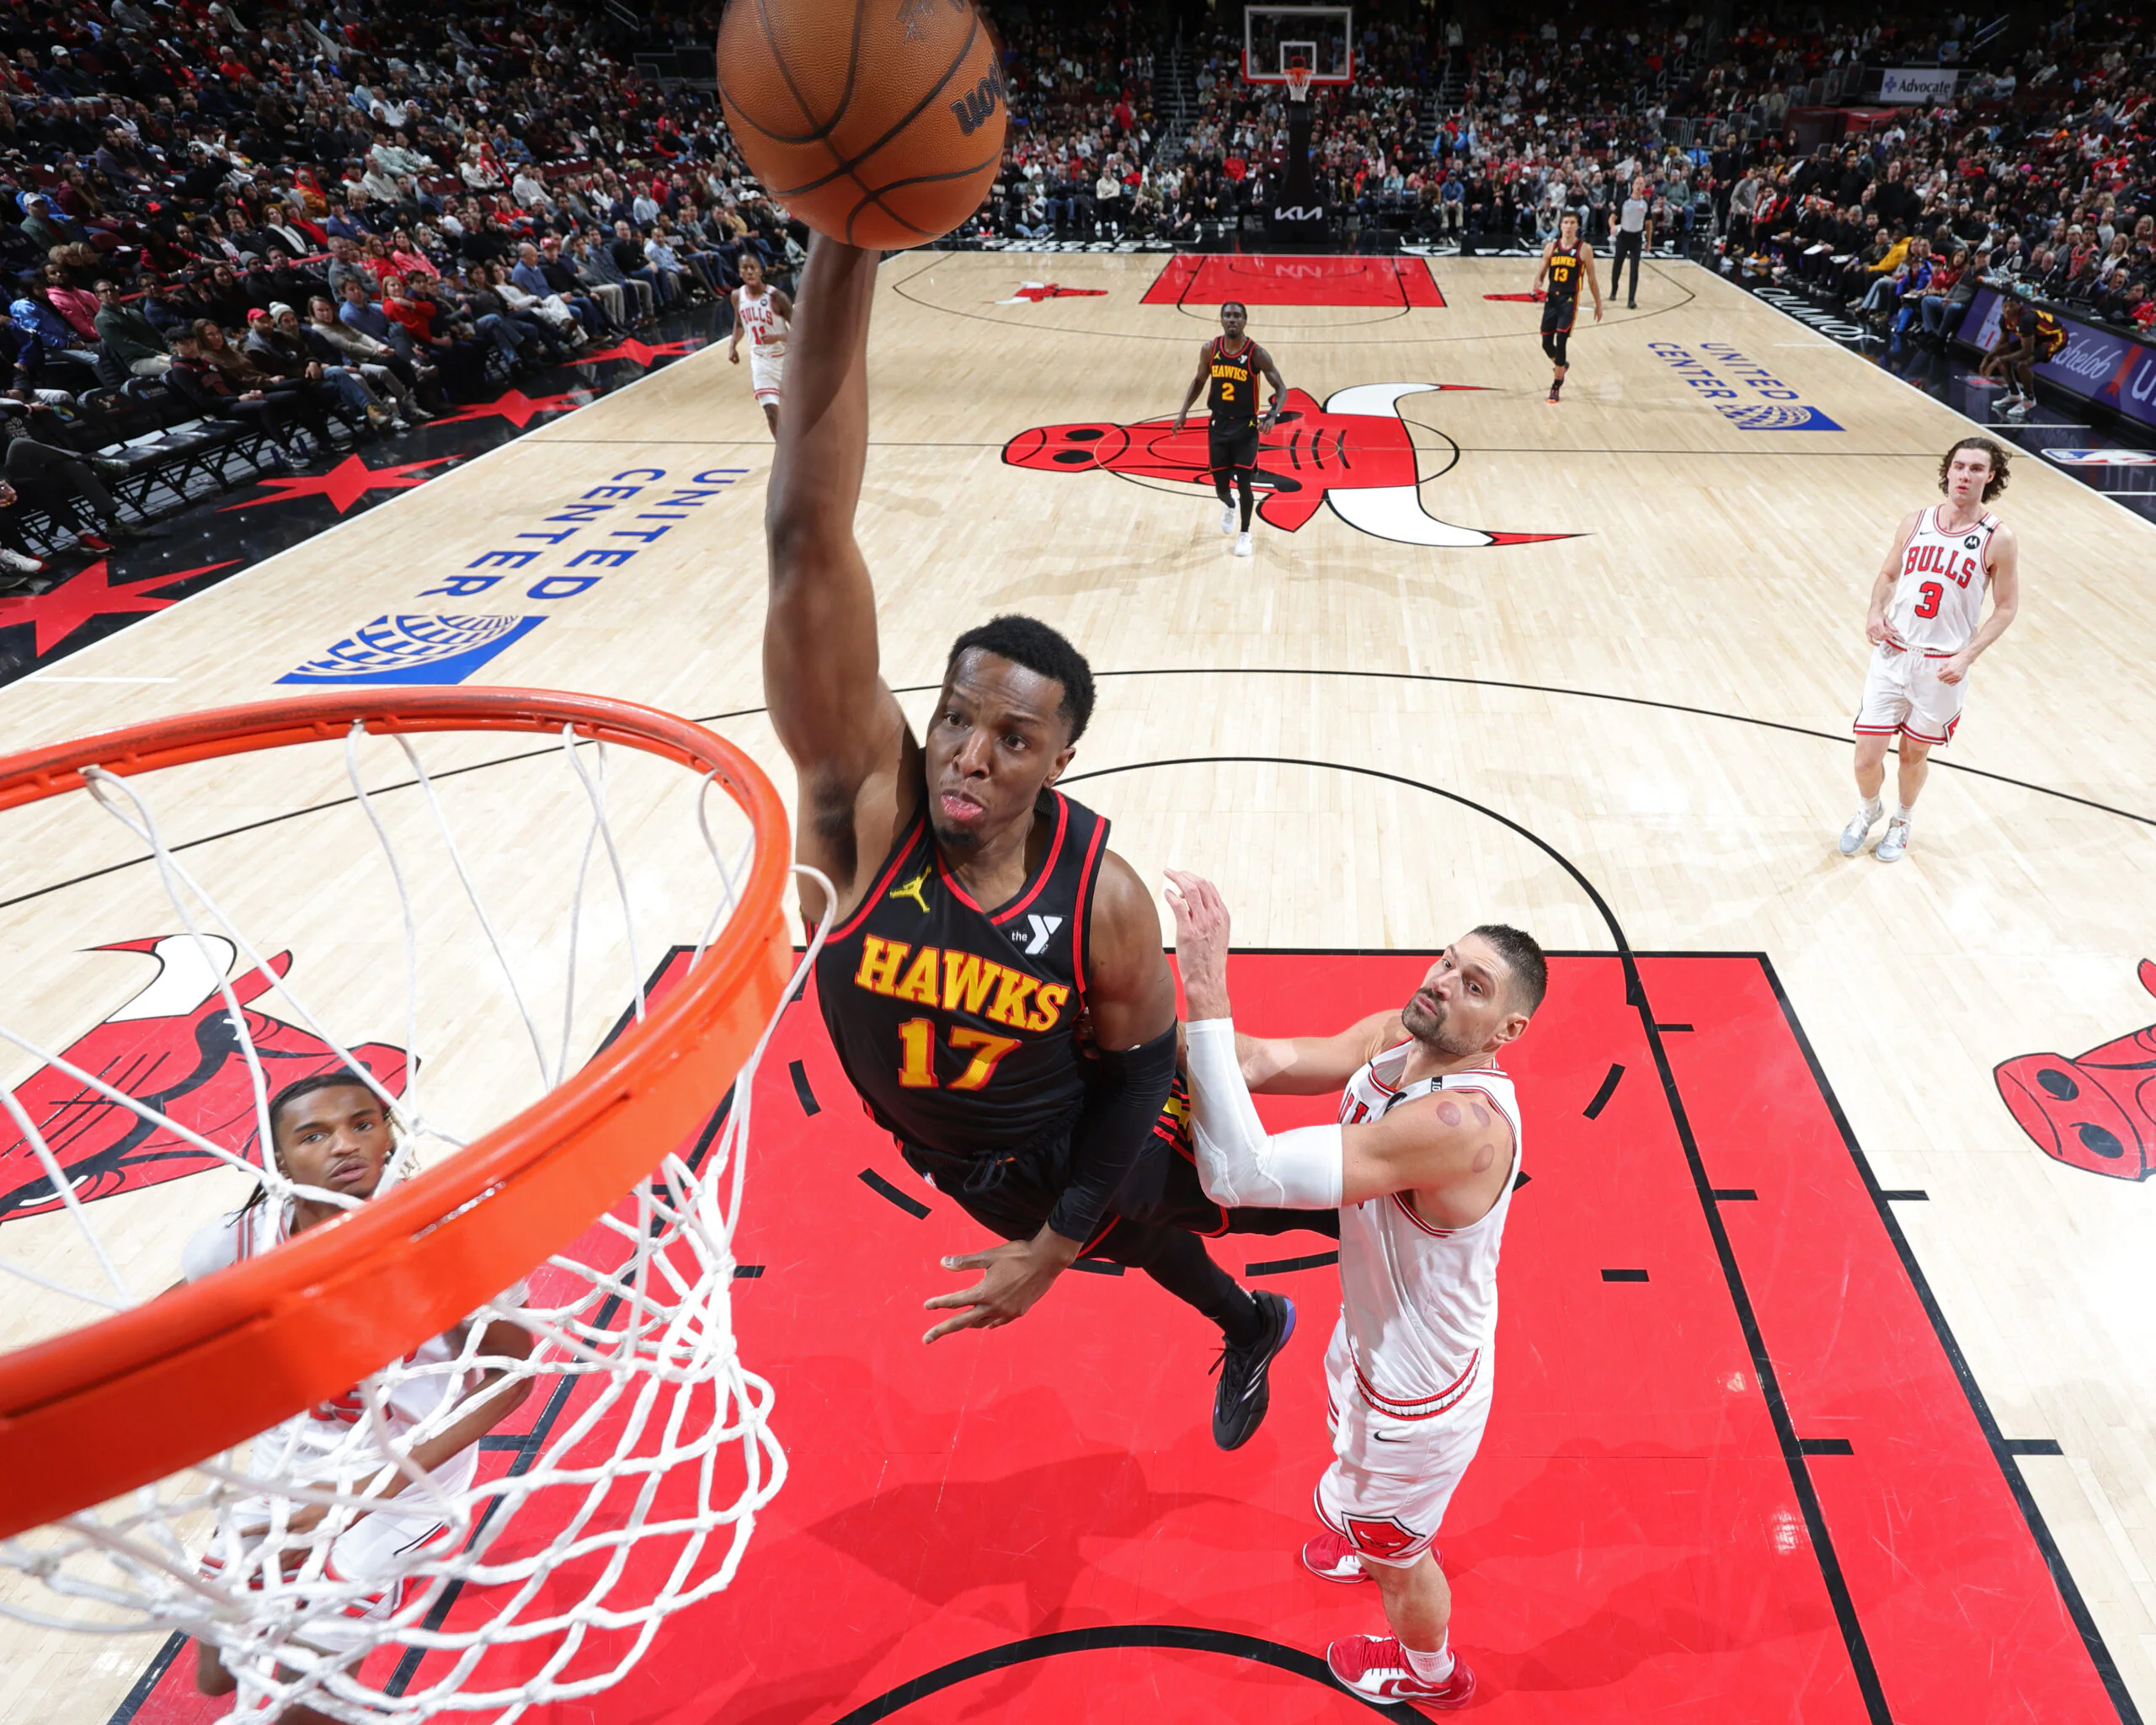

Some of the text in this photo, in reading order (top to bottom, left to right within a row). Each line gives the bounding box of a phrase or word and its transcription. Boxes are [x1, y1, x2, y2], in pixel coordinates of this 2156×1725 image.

[1898, 77, 1951, 93] Advocate
[1274, 206, 1323, 221] KIA
[1554, 267, 1569, 282] 13
[1752, 287, 1886, 343] CALAMOS
[1211, 365, 1248, 382] HAWKS
[1221, 382, 1235, 401] 2
[1647, 342, 1738, 399] CENTER
[1700, 342, 1799, 400] UNITED
[414, 468, 667, 598] CENTER
[526, 468, 750, 599] UNITED
[1903, 545, 1976, 590] BULLS
[1914, 581, 1944, 620] 3
[1011, 931, 1027, 943] the
[855, 932, 1071, 1033] HAWKS
[898, 1017, 1022, 1091] 17
